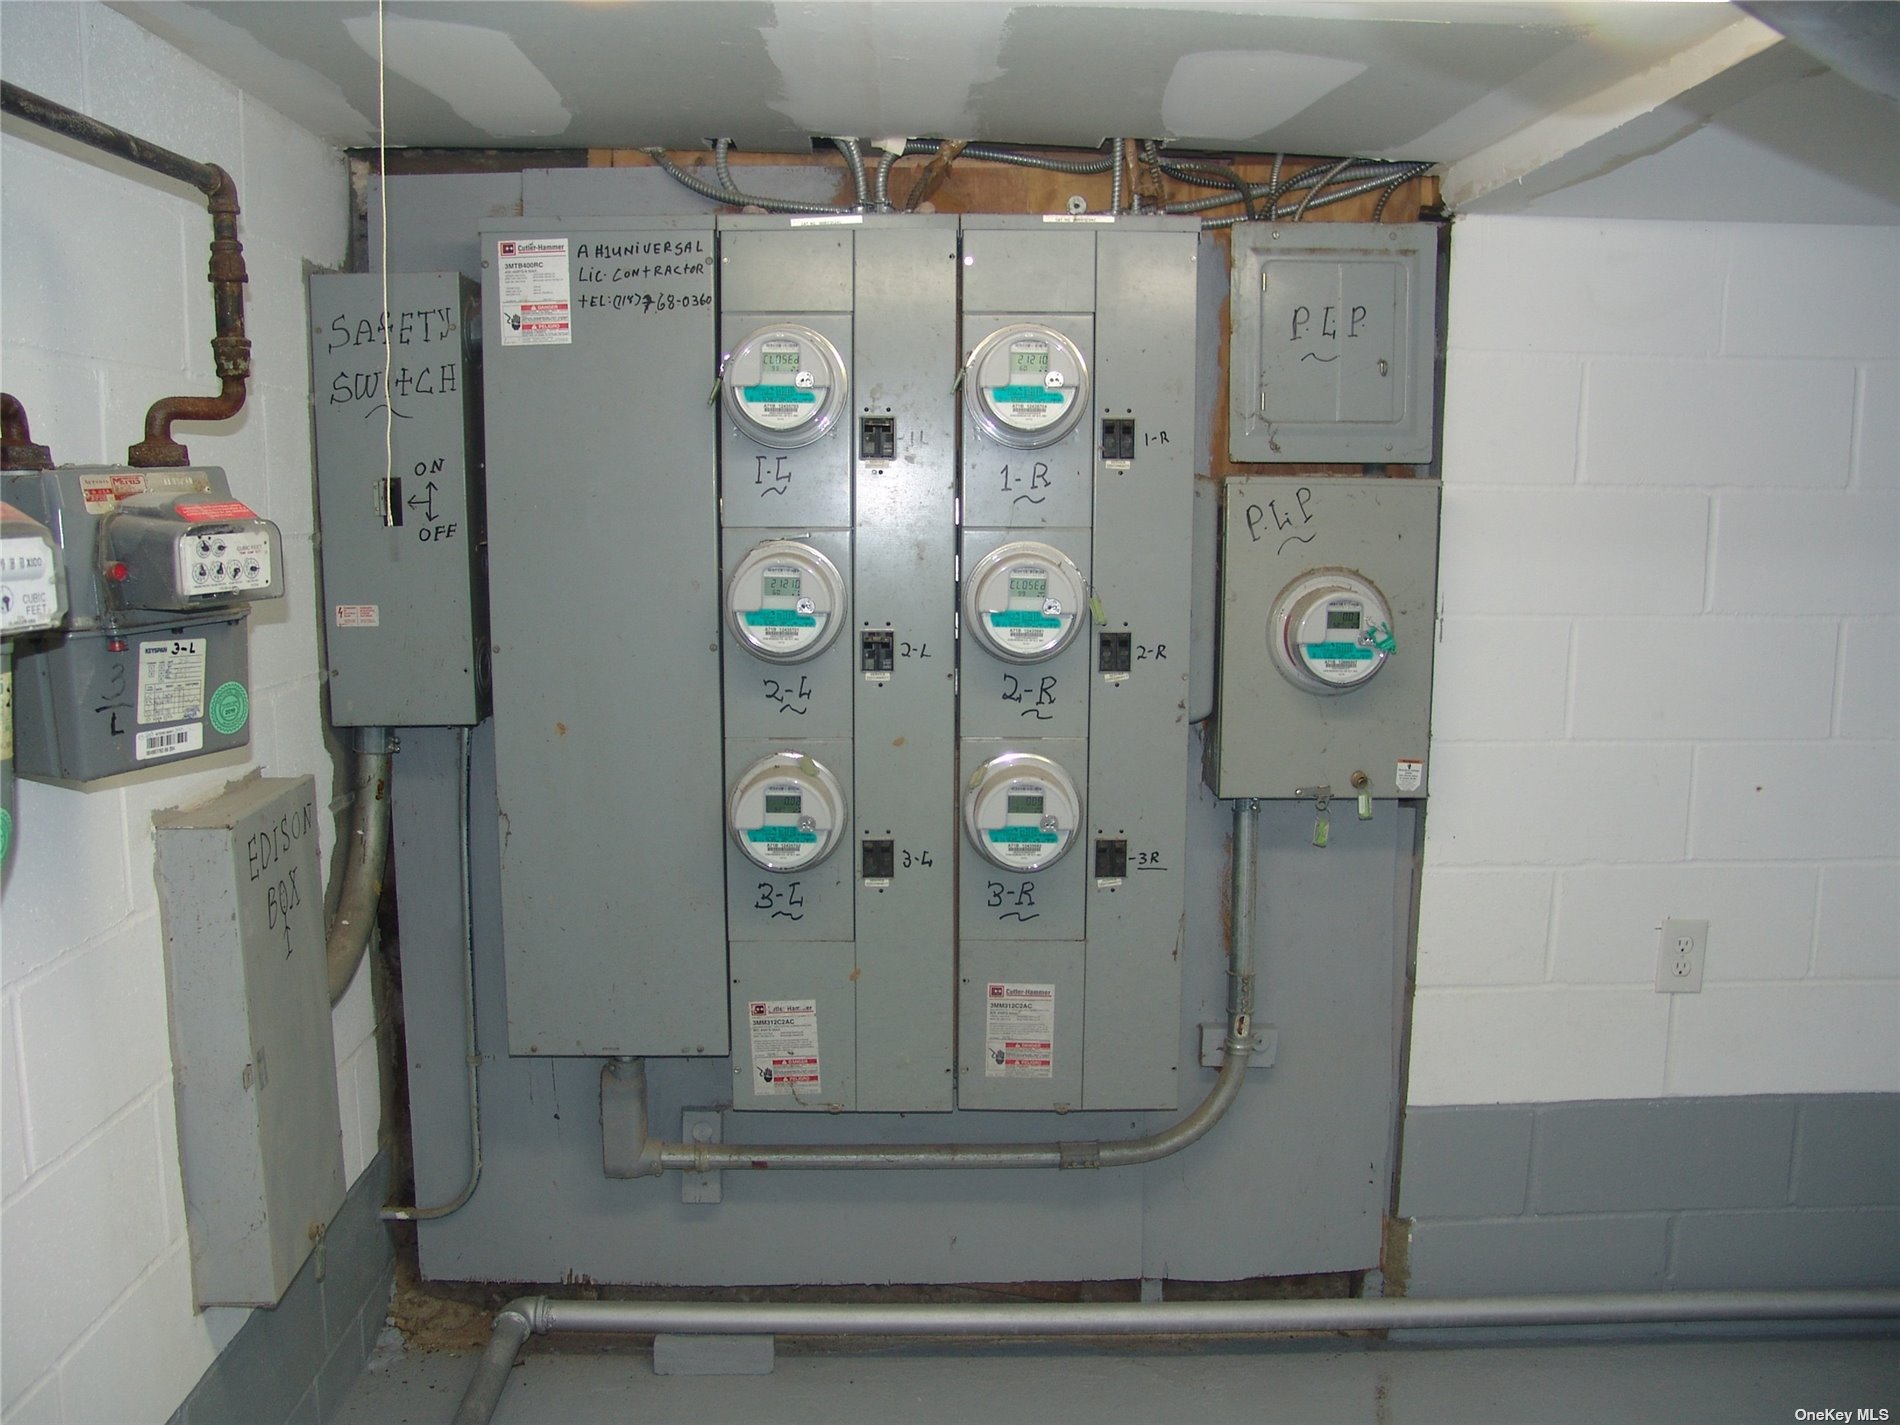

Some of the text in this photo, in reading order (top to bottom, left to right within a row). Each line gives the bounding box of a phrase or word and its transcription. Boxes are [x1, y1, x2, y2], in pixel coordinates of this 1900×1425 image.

[517, 244, 564, 252] Cutler-Hammer
[504, 262, 544, 270] 3MTB400RC
[328, 307, 451, 354] SAFETY
[1017, 354, 1048, 365] 21210
[329, 364, 457, 405] SWTCH
[1144, 431, 1170, 447] 1-R
[414, 458, 446, 477] ON
[1000, 462, 1051, 492] 1-R
[418, 523, 458, 542] OFF
[770, 577, 801, 589] 21210
[22, 592, 46, 604] CUBIC
[26, 604, 47, 615] FEET
[171, 642, 196, 655] 3-L
[900, 642, 932, 658] 2-L
[1136, 644, 1167, 660] 2-R
[1001, 673, 1057, 705] 2-R
[247, 803, 312, 881] EDISON
[902, 850, 933, 868] 3-L
[268, 866, 301, 930] BOX
[754, 882, 804, 909] 3-L
[987, 880, 1036, 907] 3-R
